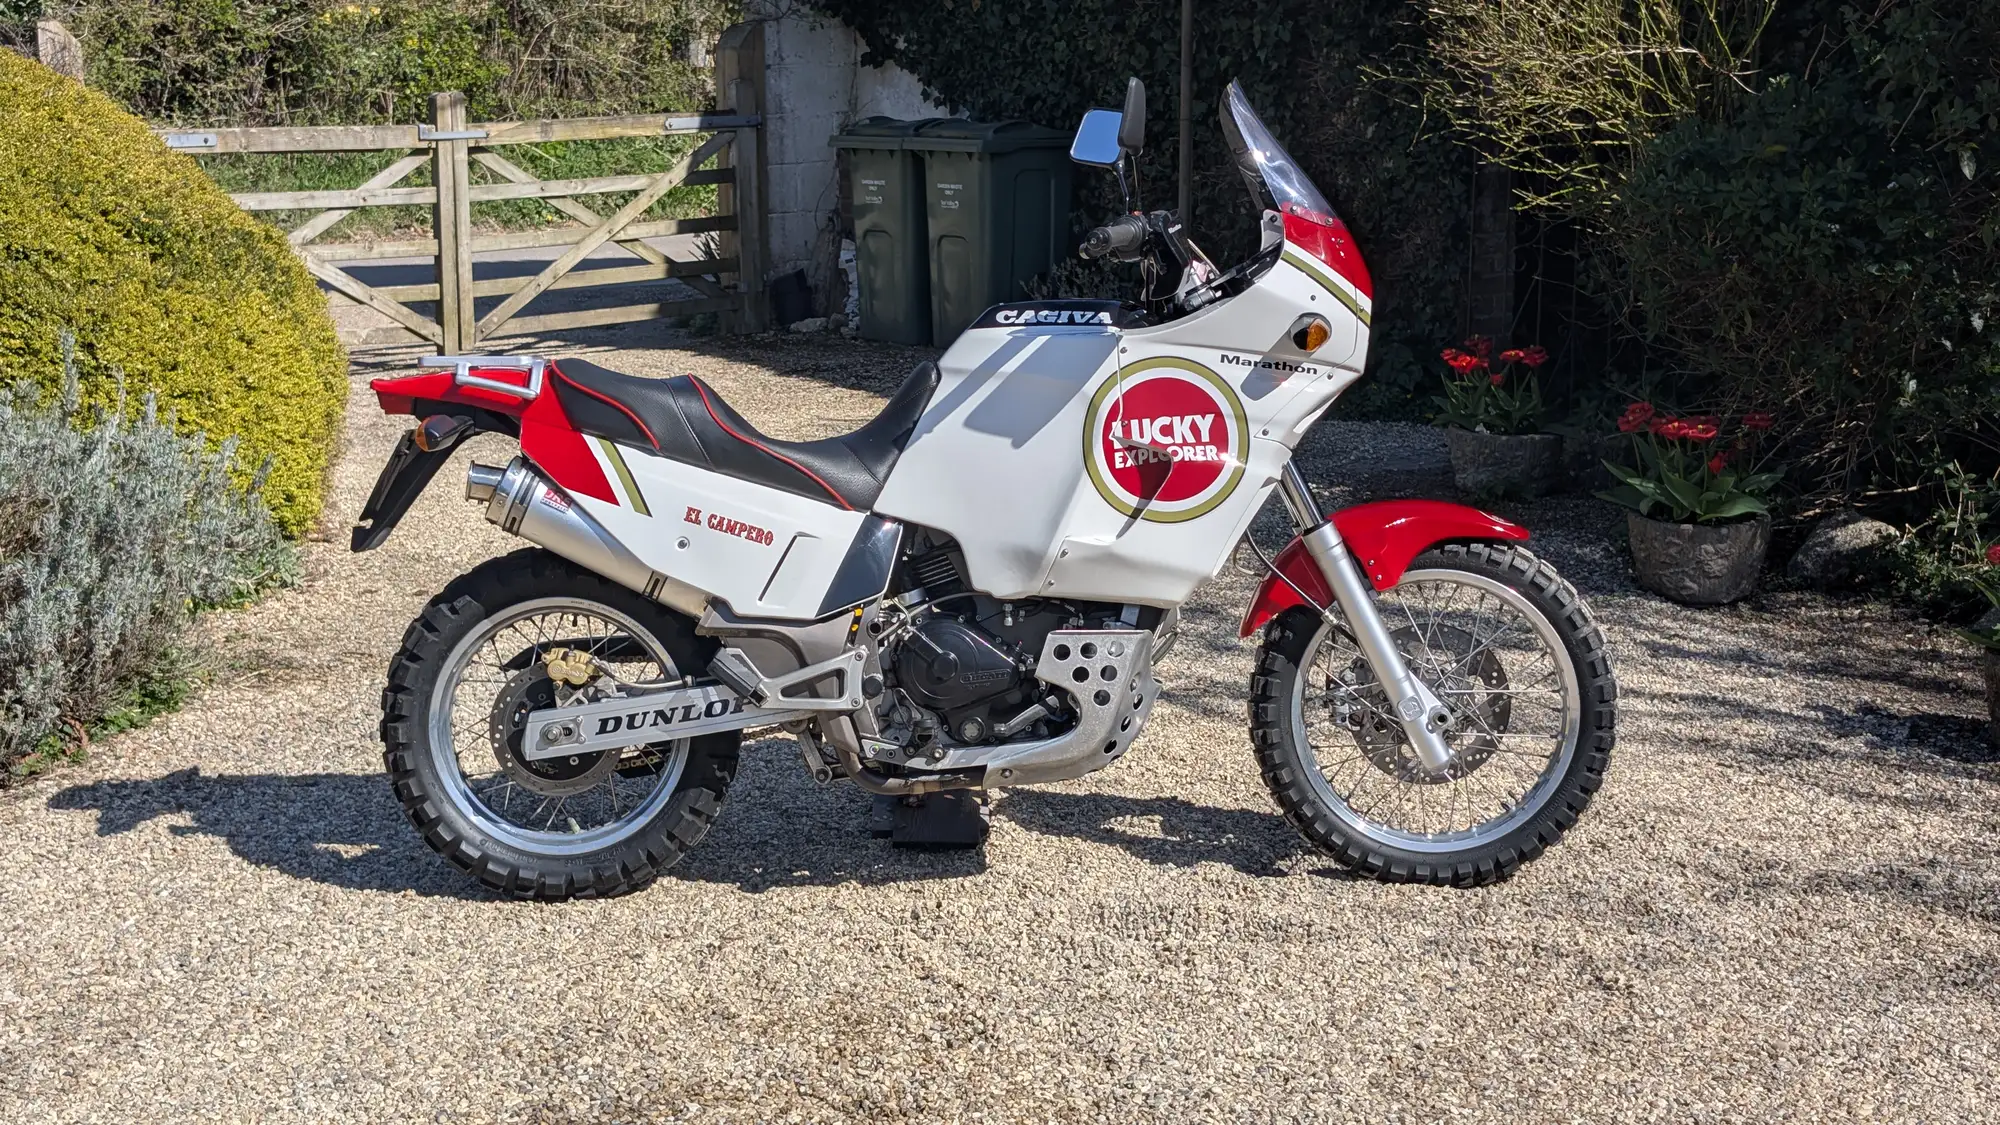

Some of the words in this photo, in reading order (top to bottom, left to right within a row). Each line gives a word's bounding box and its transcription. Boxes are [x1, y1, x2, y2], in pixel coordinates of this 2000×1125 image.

[995, 309, 1113, 325] CAGIVA
[1220, 353, 1318, 375] Marathon
[1111, 413, 1216, 449] LUCKY
[1114, 445, 1219, 469] EXPLORER
[684, 506, 702, 526] EL
[707, 513, 774, 547] CAMPERO
